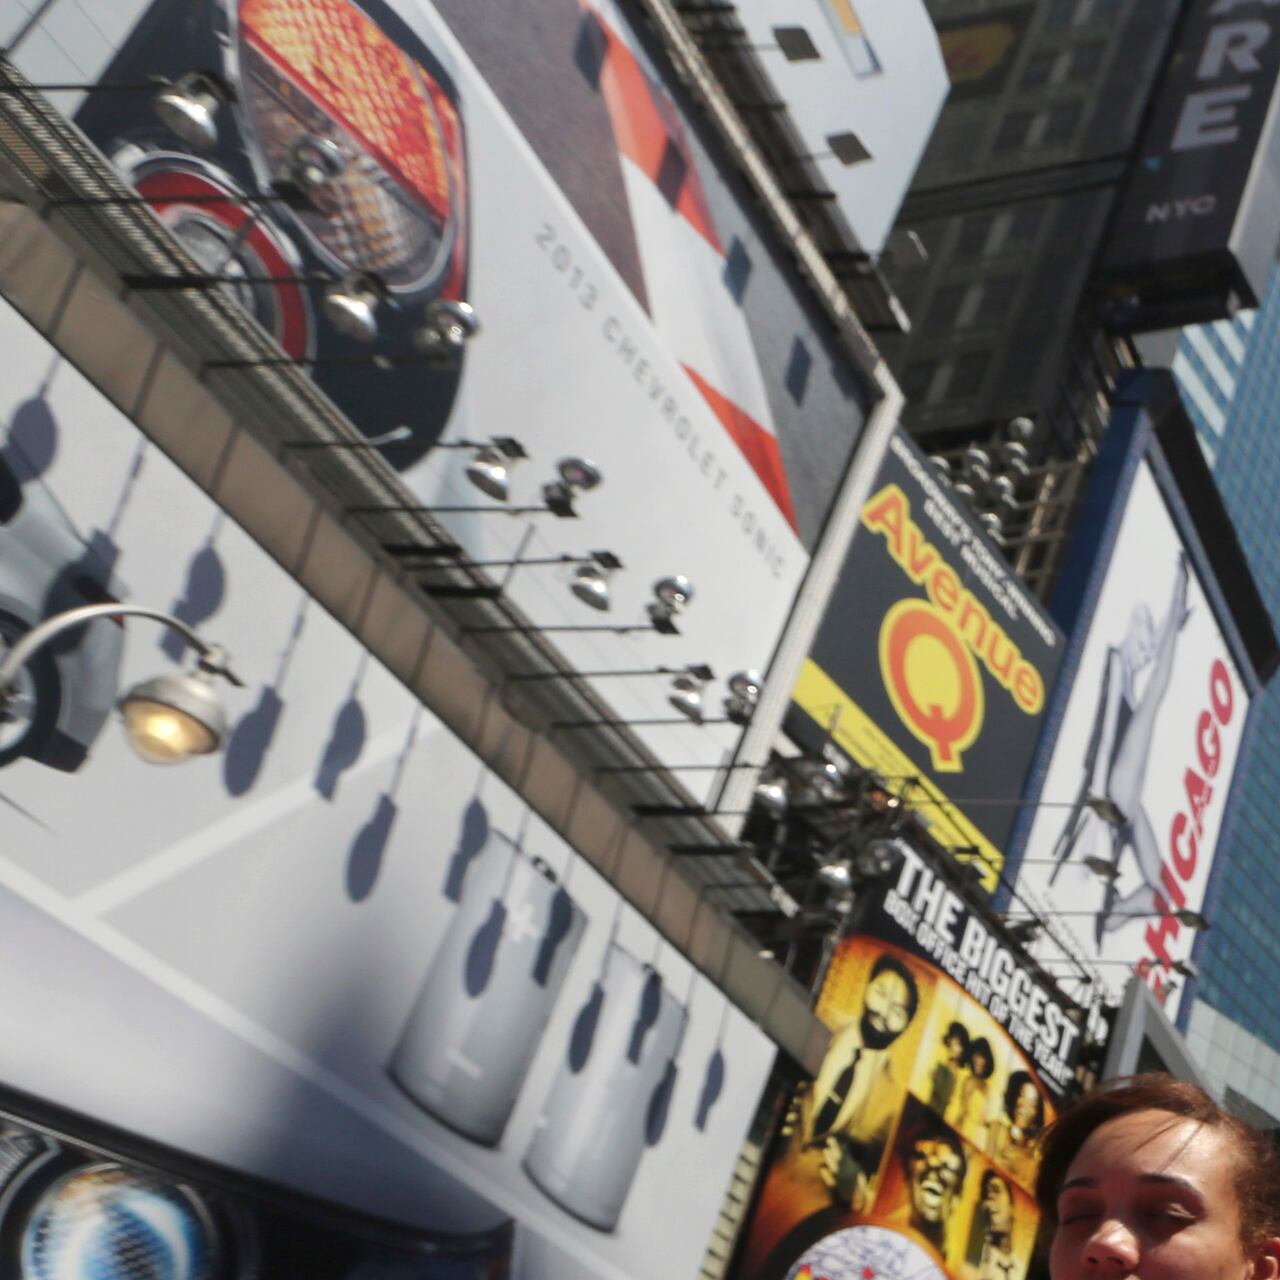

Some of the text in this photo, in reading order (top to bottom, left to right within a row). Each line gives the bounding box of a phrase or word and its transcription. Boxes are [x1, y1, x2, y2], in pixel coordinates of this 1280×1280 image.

[603, 316, 728, 489] CHEVROLET
[729, 495, 787, 578] SONIC
[860, 483, 1045, 715] Avenue
[878, 597, 985, 773] Q
[884, 888, 922, 937] BOX
[915, 920, 970, 985] OFFICE
[964, 968, 992, 1008] HIT
[988, 992, 1014, 1026] OF
[1008, 1013, 1037, 1052] THE
[895, 840, 964, 944] THE
[959, 915, 1080, 1061] BIGGEST
